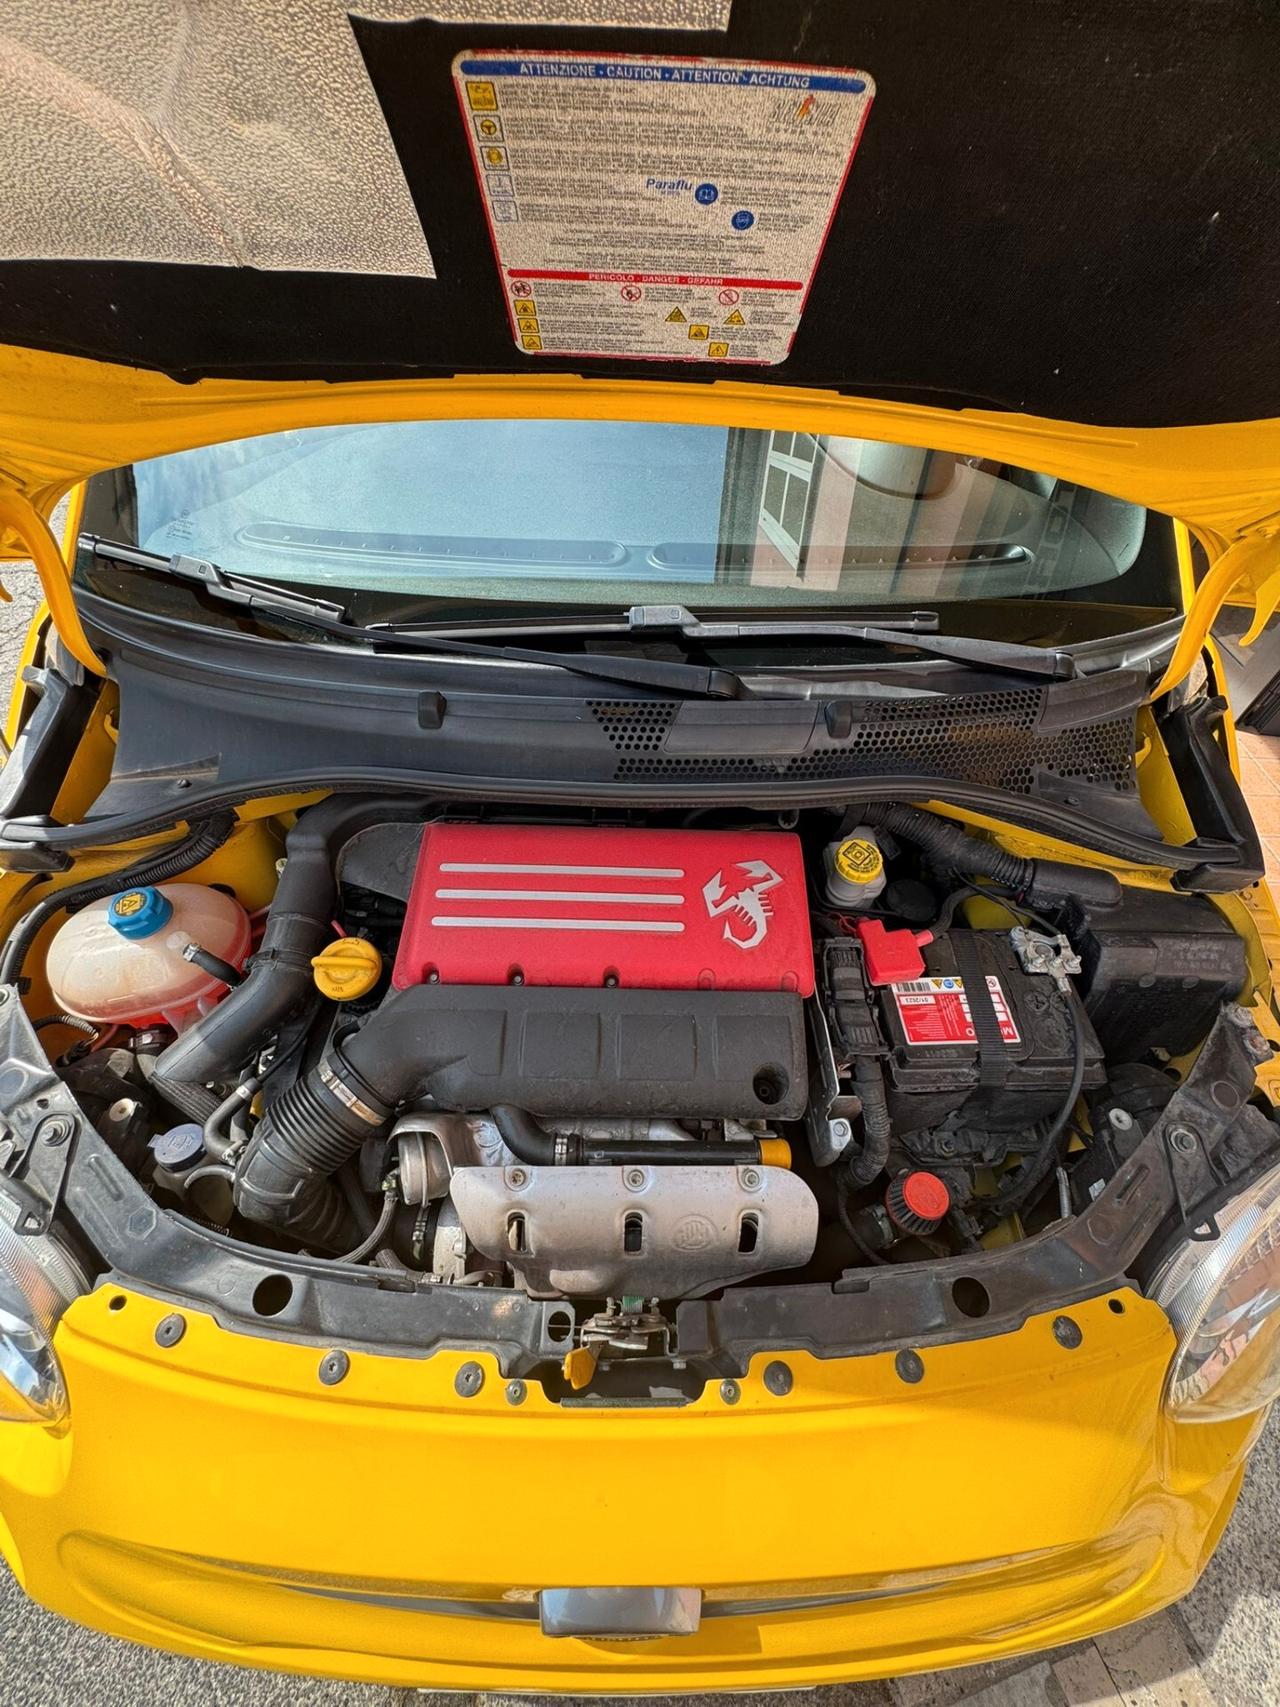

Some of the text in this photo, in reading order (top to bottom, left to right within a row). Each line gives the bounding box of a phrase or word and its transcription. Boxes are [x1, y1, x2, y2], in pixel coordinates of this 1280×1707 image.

[520, 63, 810, 88] ATTENZIONE CAUTION ATTENTION ACHTUNG
[646, 178, 693, 191] Paraflu
[588, 273, 724, 285] PERICOLO DANGER GEFAHR
